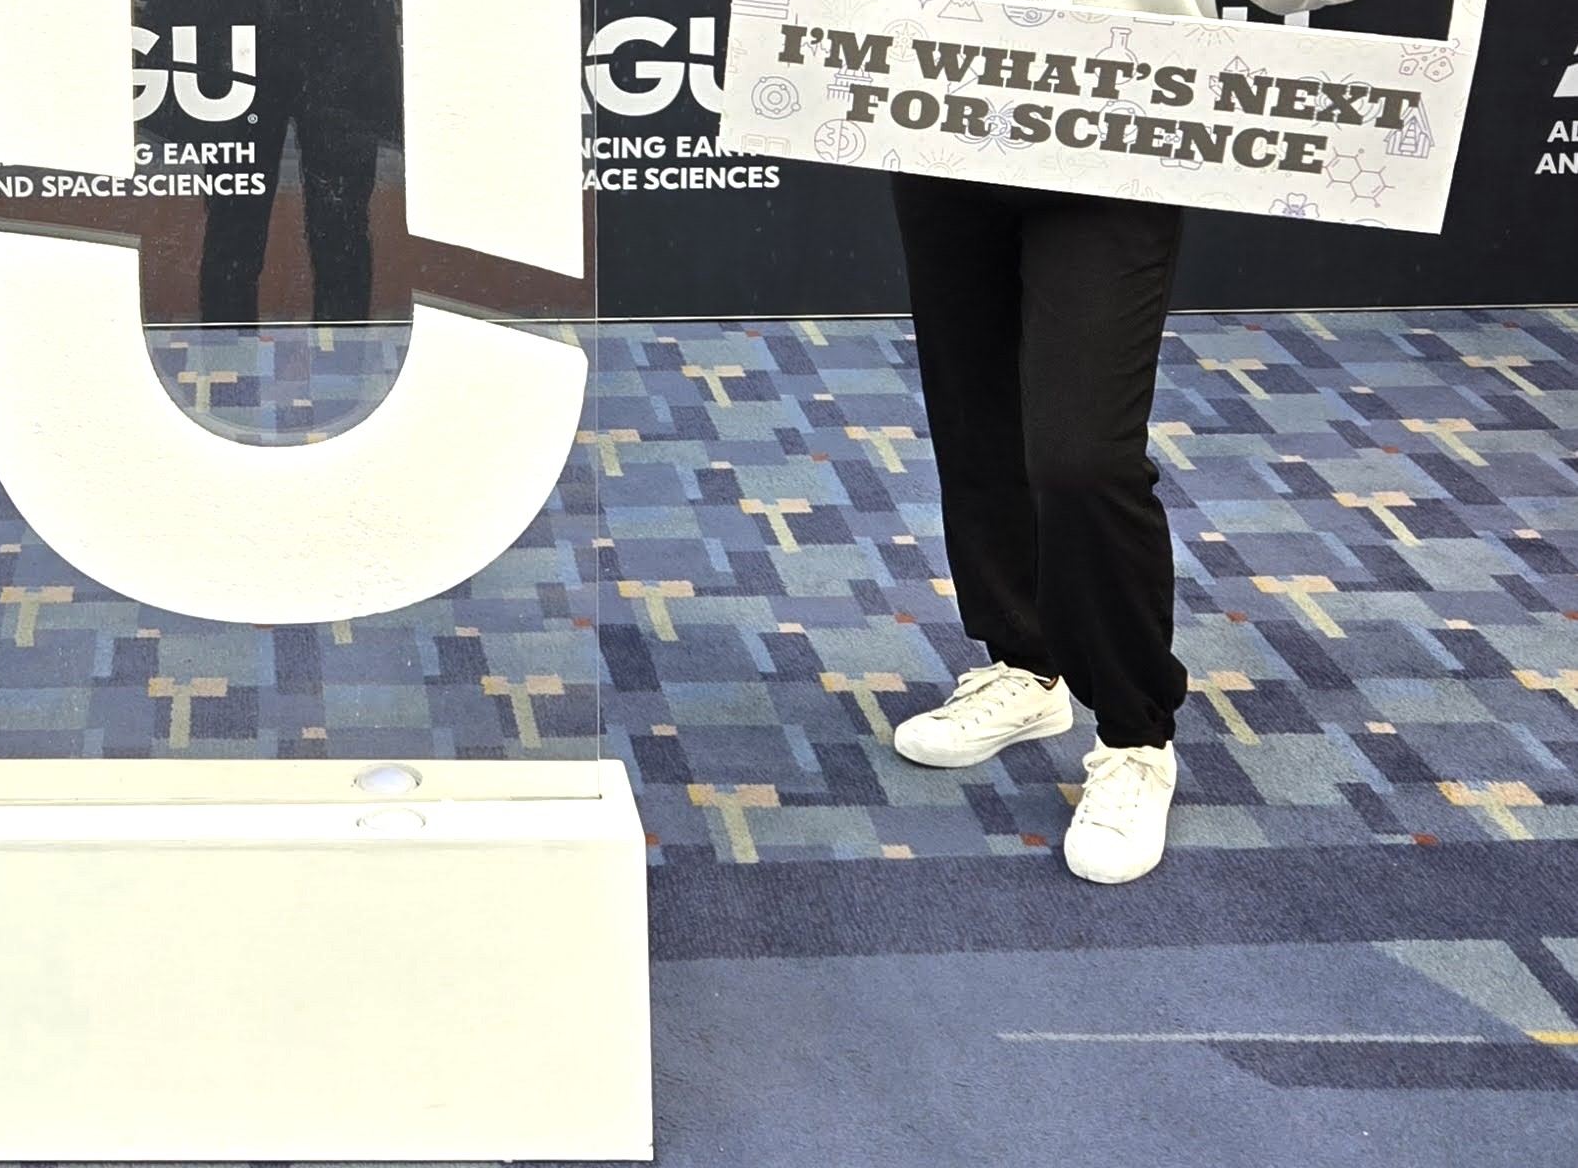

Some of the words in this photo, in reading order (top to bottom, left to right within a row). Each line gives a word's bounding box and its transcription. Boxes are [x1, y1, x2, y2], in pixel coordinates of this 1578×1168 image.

[777, 24, 893, 74] I'M
[912, 40, 1197, 107] WHAT'S
[1215, 71, 1421, 129] NEXT
[846, 84, 999, 138] FOR
[1010, 103, 1329, 174] SCIENCE
[164, 142, 254, 164] EARTH
[42, 175, 125, 198] SPACE
[133, 173, 265, 196] SCIENCES
[644, 166, 779, 189] SCIENCES
